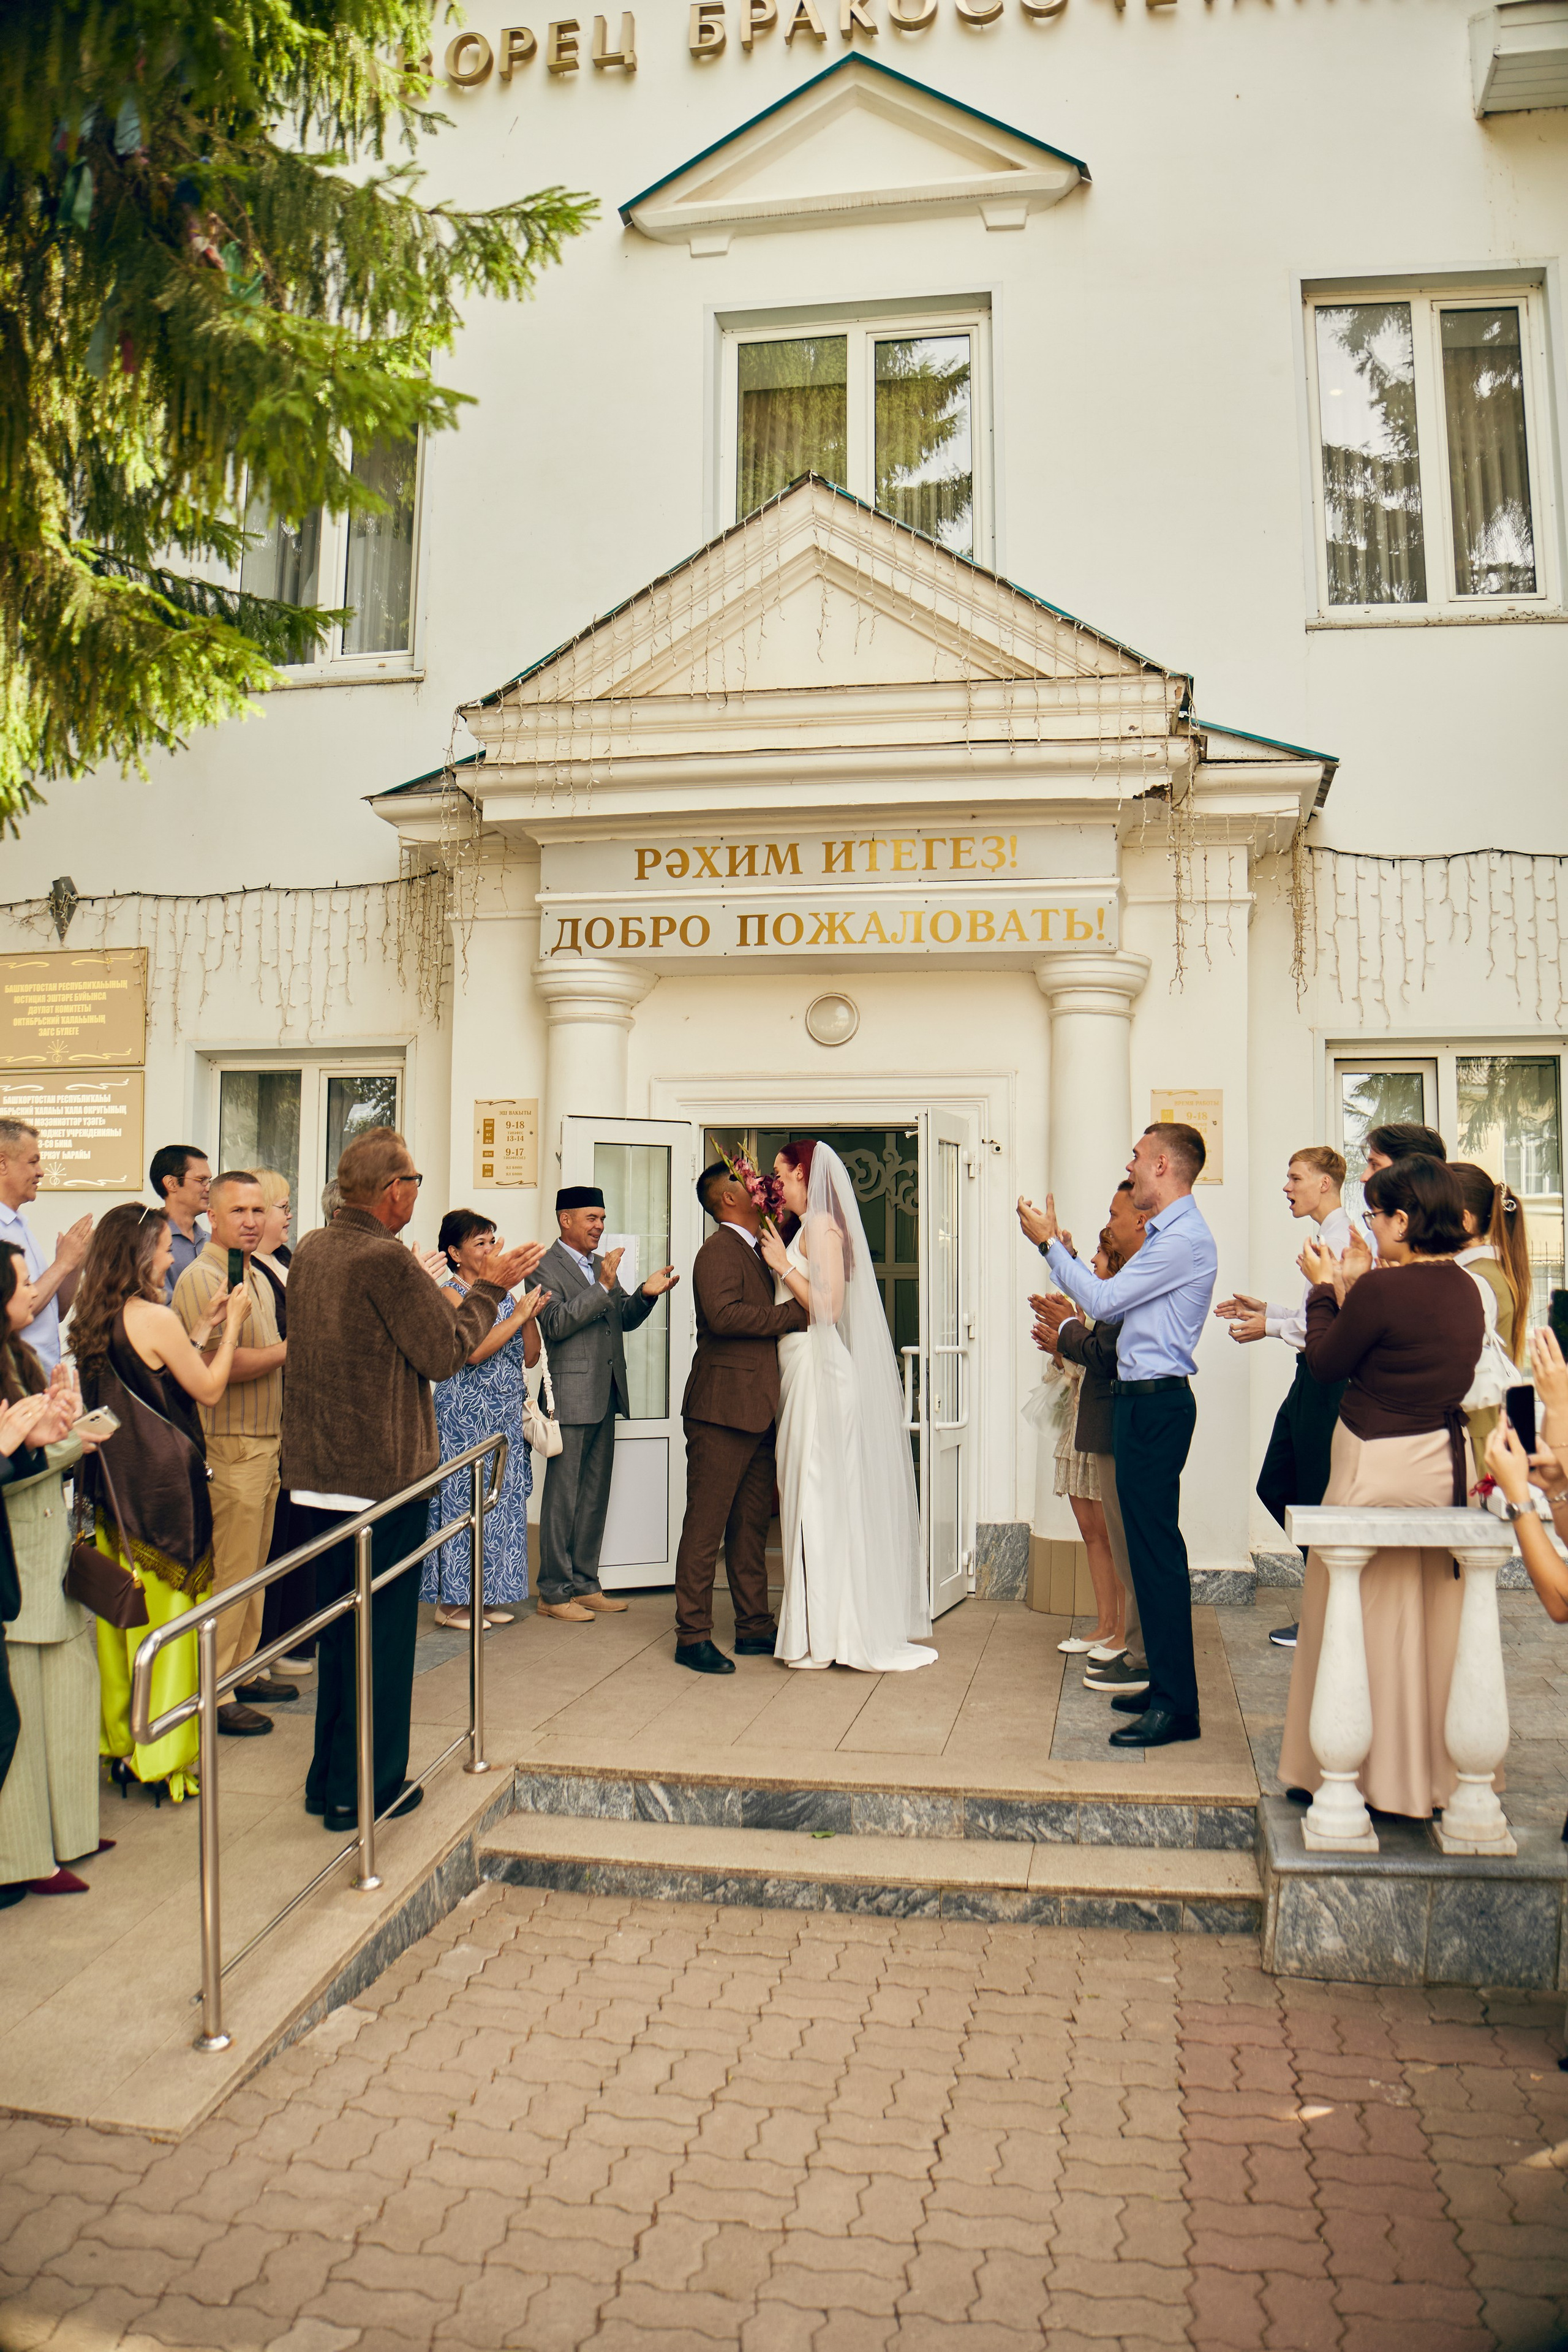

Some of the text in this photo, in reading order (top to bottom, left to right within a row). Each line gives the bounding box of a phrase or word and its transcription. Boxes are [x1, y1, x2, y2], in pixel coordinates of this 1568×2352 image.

[551, 907, 1105, 957] ДОБРО ПОЖАЛОВАТЬ!
[55, 1004, 91, 1013] КОМИТЕТЫ
[13, 1015, 60, 1026] ОКТЯБРЬСКИЙ
[38, 1027, 55, 1036] ЗАГС
[1186, 1112, 1208, 1120] 9-18
